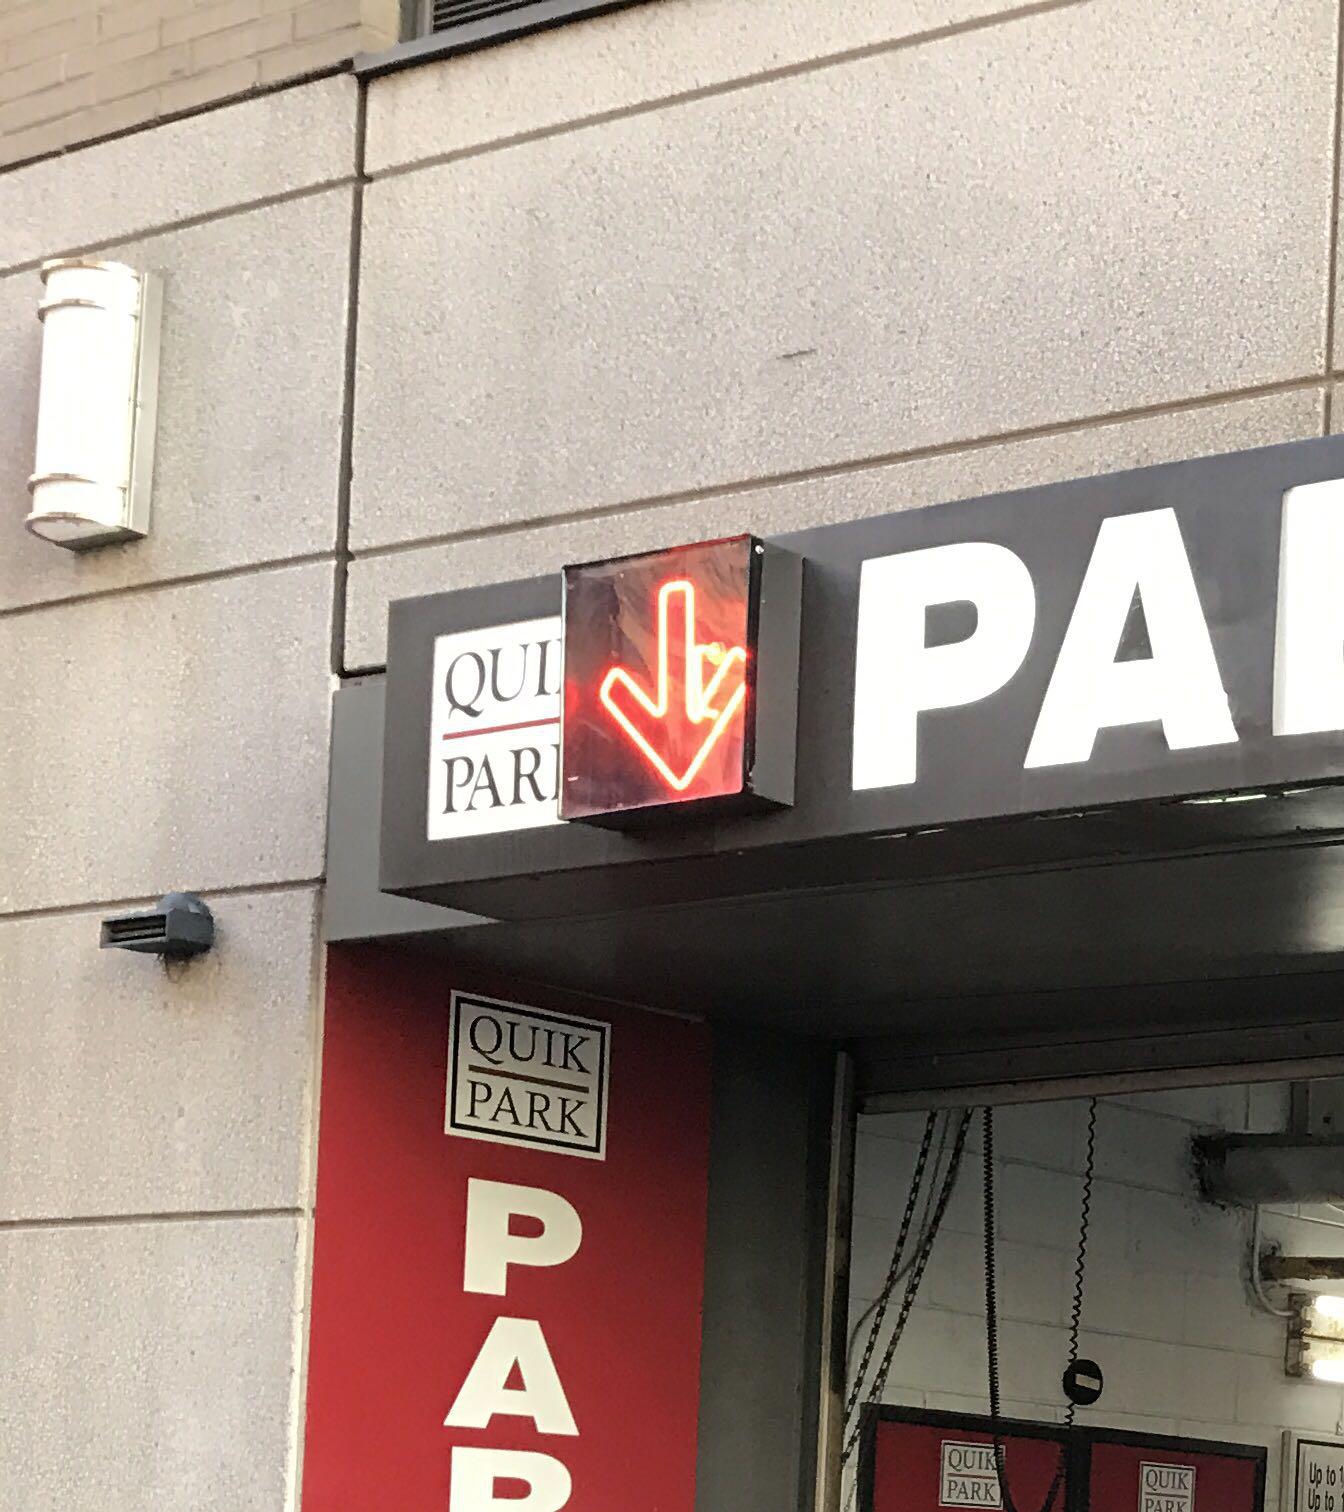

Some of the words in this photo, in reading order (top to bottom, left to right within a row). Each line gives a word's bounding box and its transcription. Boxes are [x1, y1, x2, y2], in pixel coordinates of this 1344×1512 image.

[445, 638, 561, 719] QUI
[469, 1015, 591, 1074] QUIK
[465, 1080, 589, 1138] PARK
[1145, 1470, 1188, 1490] QUIK
[1309, 1462, 1322, 1485] Up
[1326, 1465, 1336, 1484] to
[947, 1479, 996, 1502] PARK
[1308, 1488, 1321, 1512] Up
[1324, 1491, 1334, 1511] to
